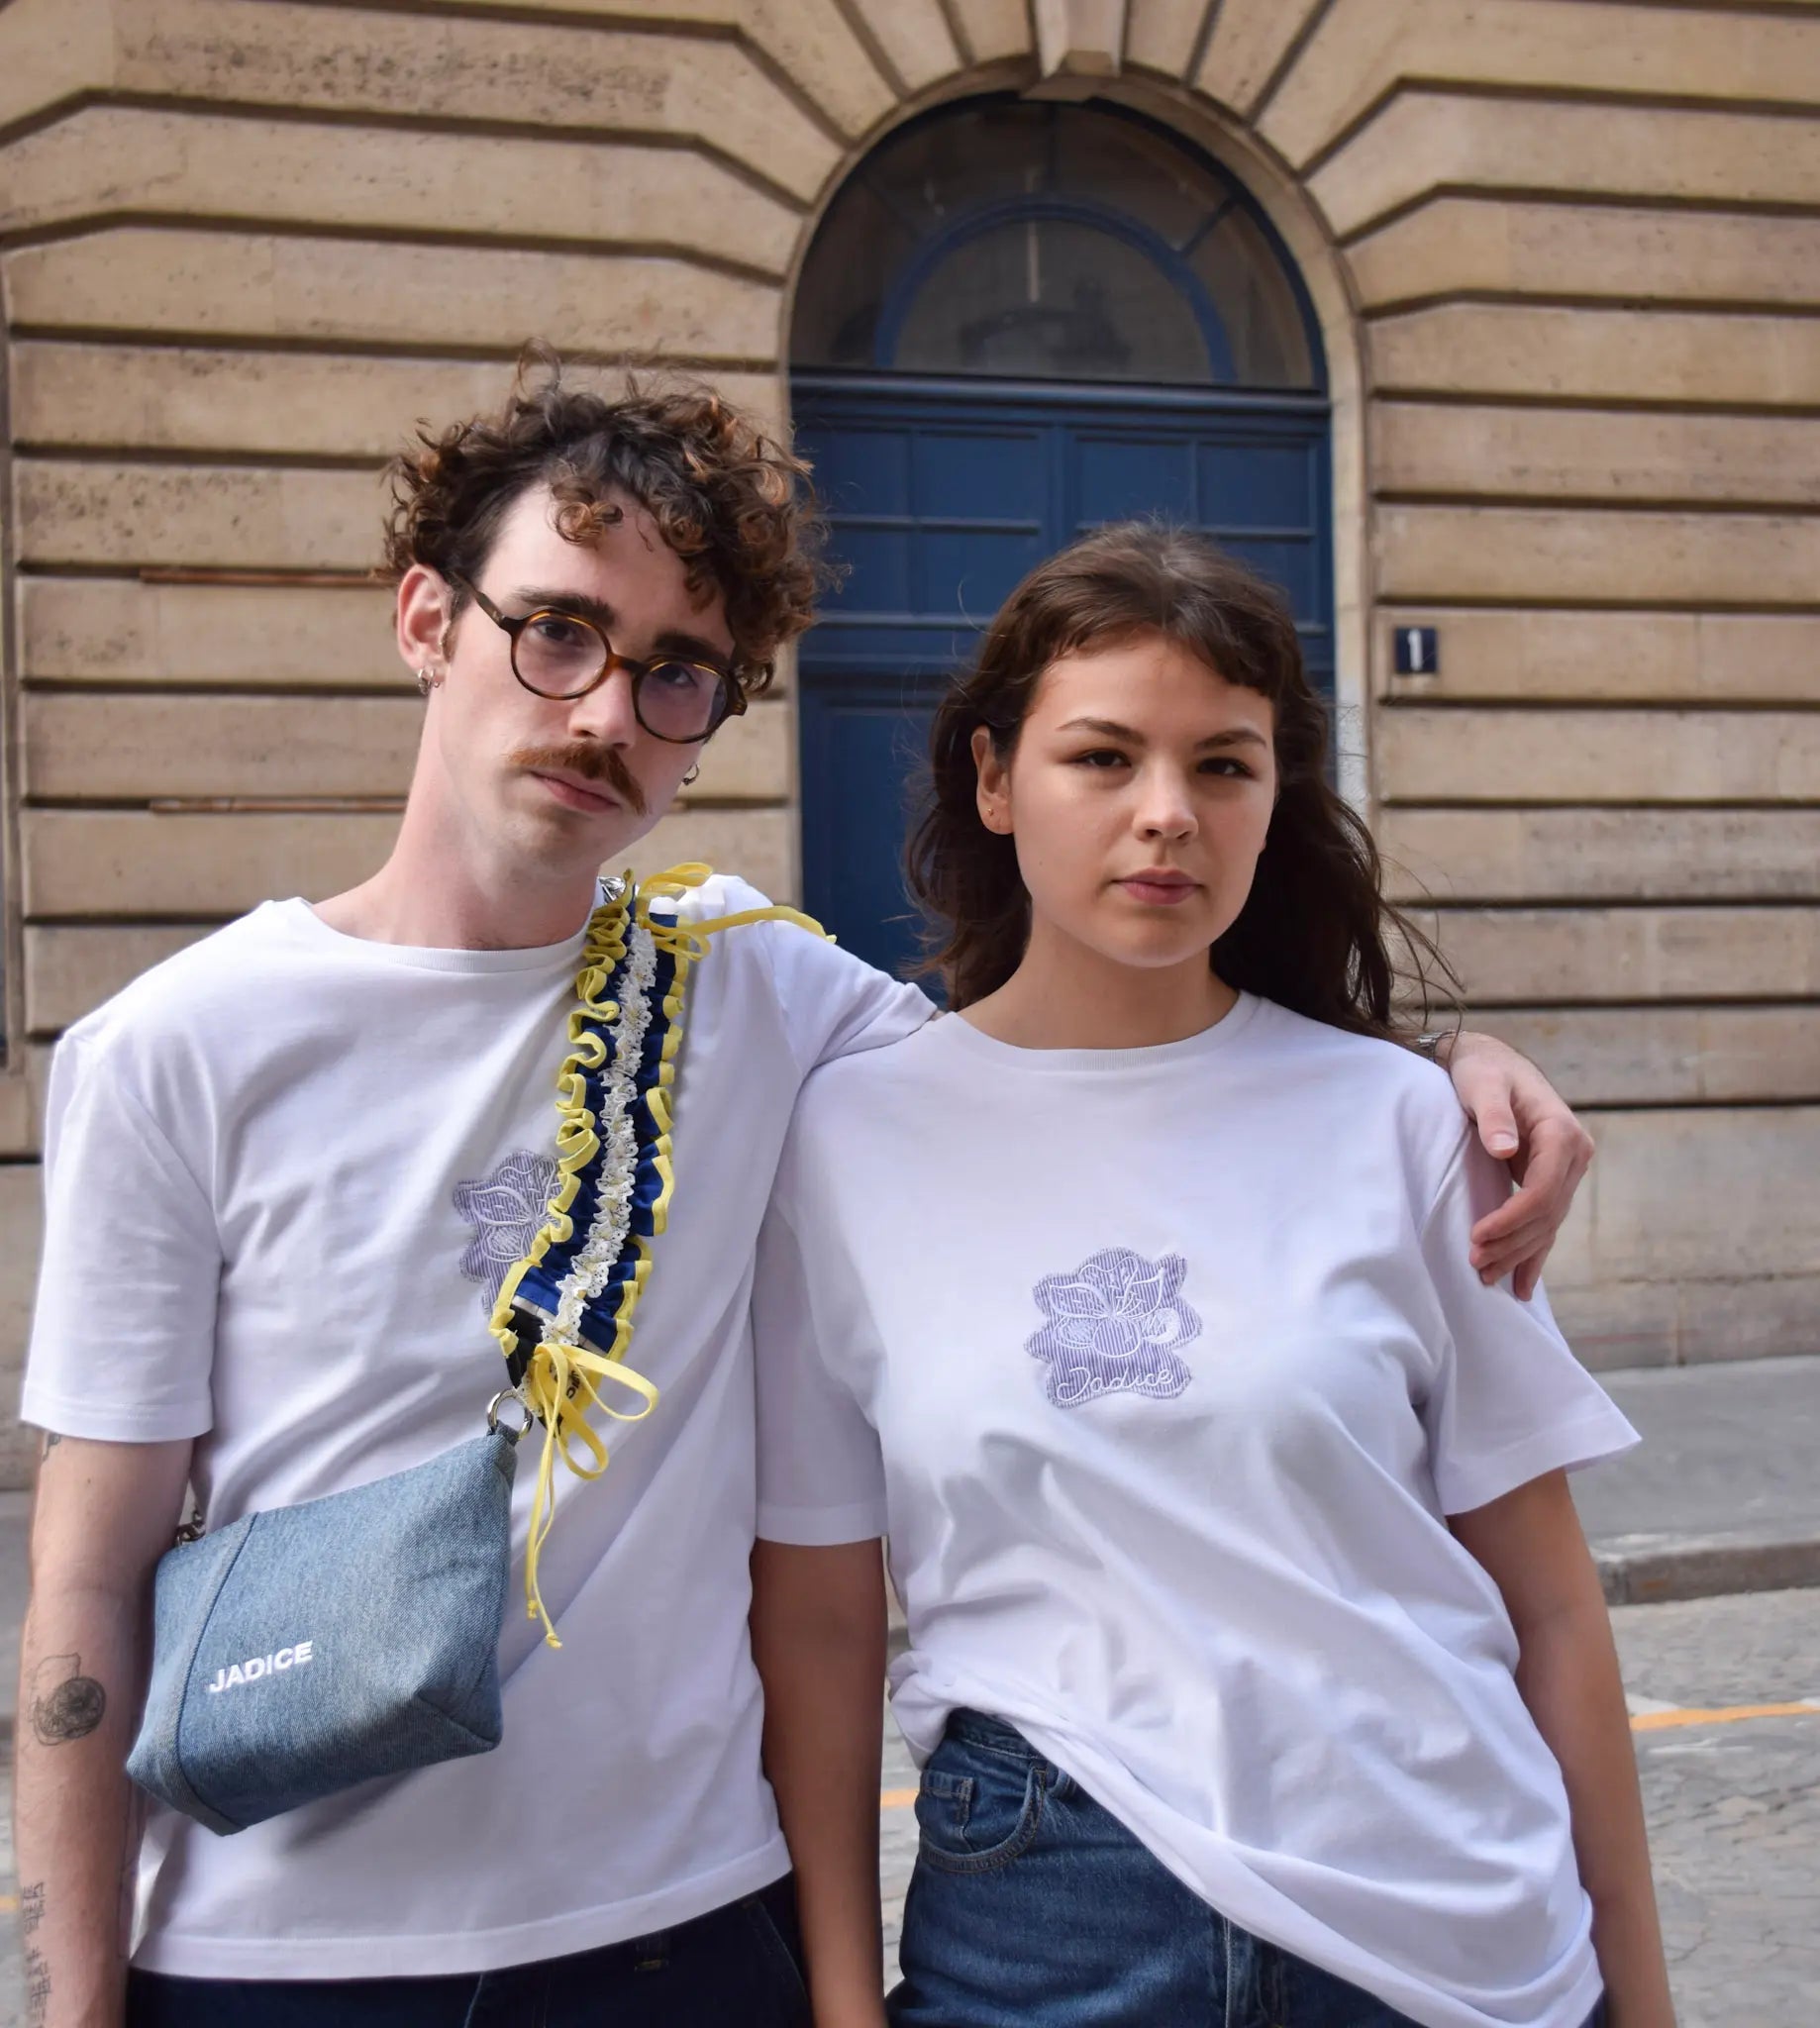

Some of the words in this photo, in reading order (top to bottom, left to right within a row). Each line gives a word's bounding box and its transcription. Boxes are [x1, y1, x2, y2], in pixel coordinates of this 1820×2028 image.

[1407, 628, 1424, 671] 1
[1056, 1366, 1174, 1402] Jadice
[208, 1640, 314, 1694] JADICE
